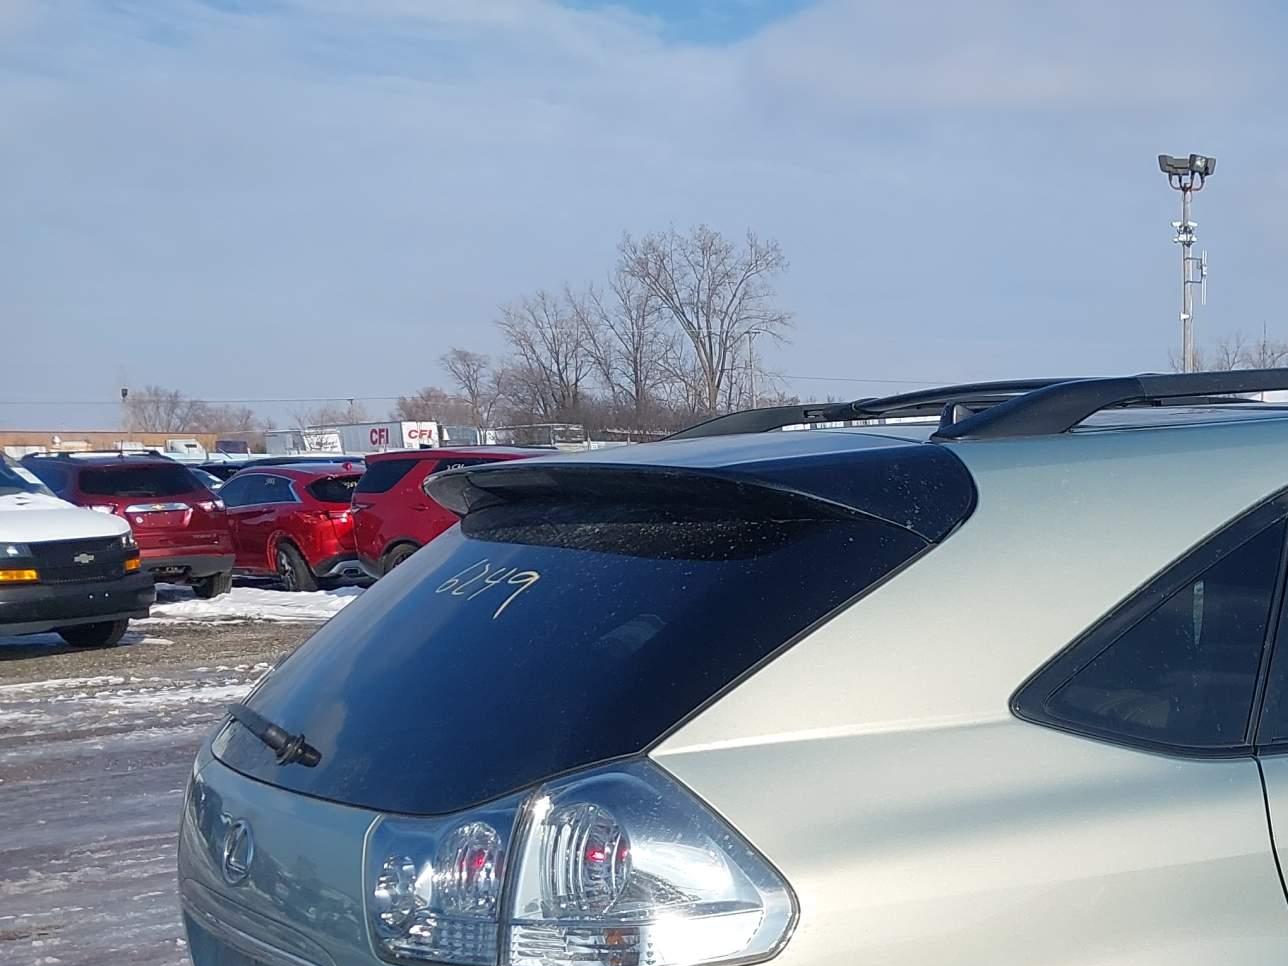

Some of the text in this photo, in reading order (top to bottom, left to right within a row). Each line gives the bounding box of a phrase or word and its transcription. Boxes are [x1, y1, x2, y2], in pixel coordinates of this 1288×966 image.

[369, 428, 389, 446] CFI
[407, 429, 433, 439] CFI
[435, 558, 540, 620] 6249
